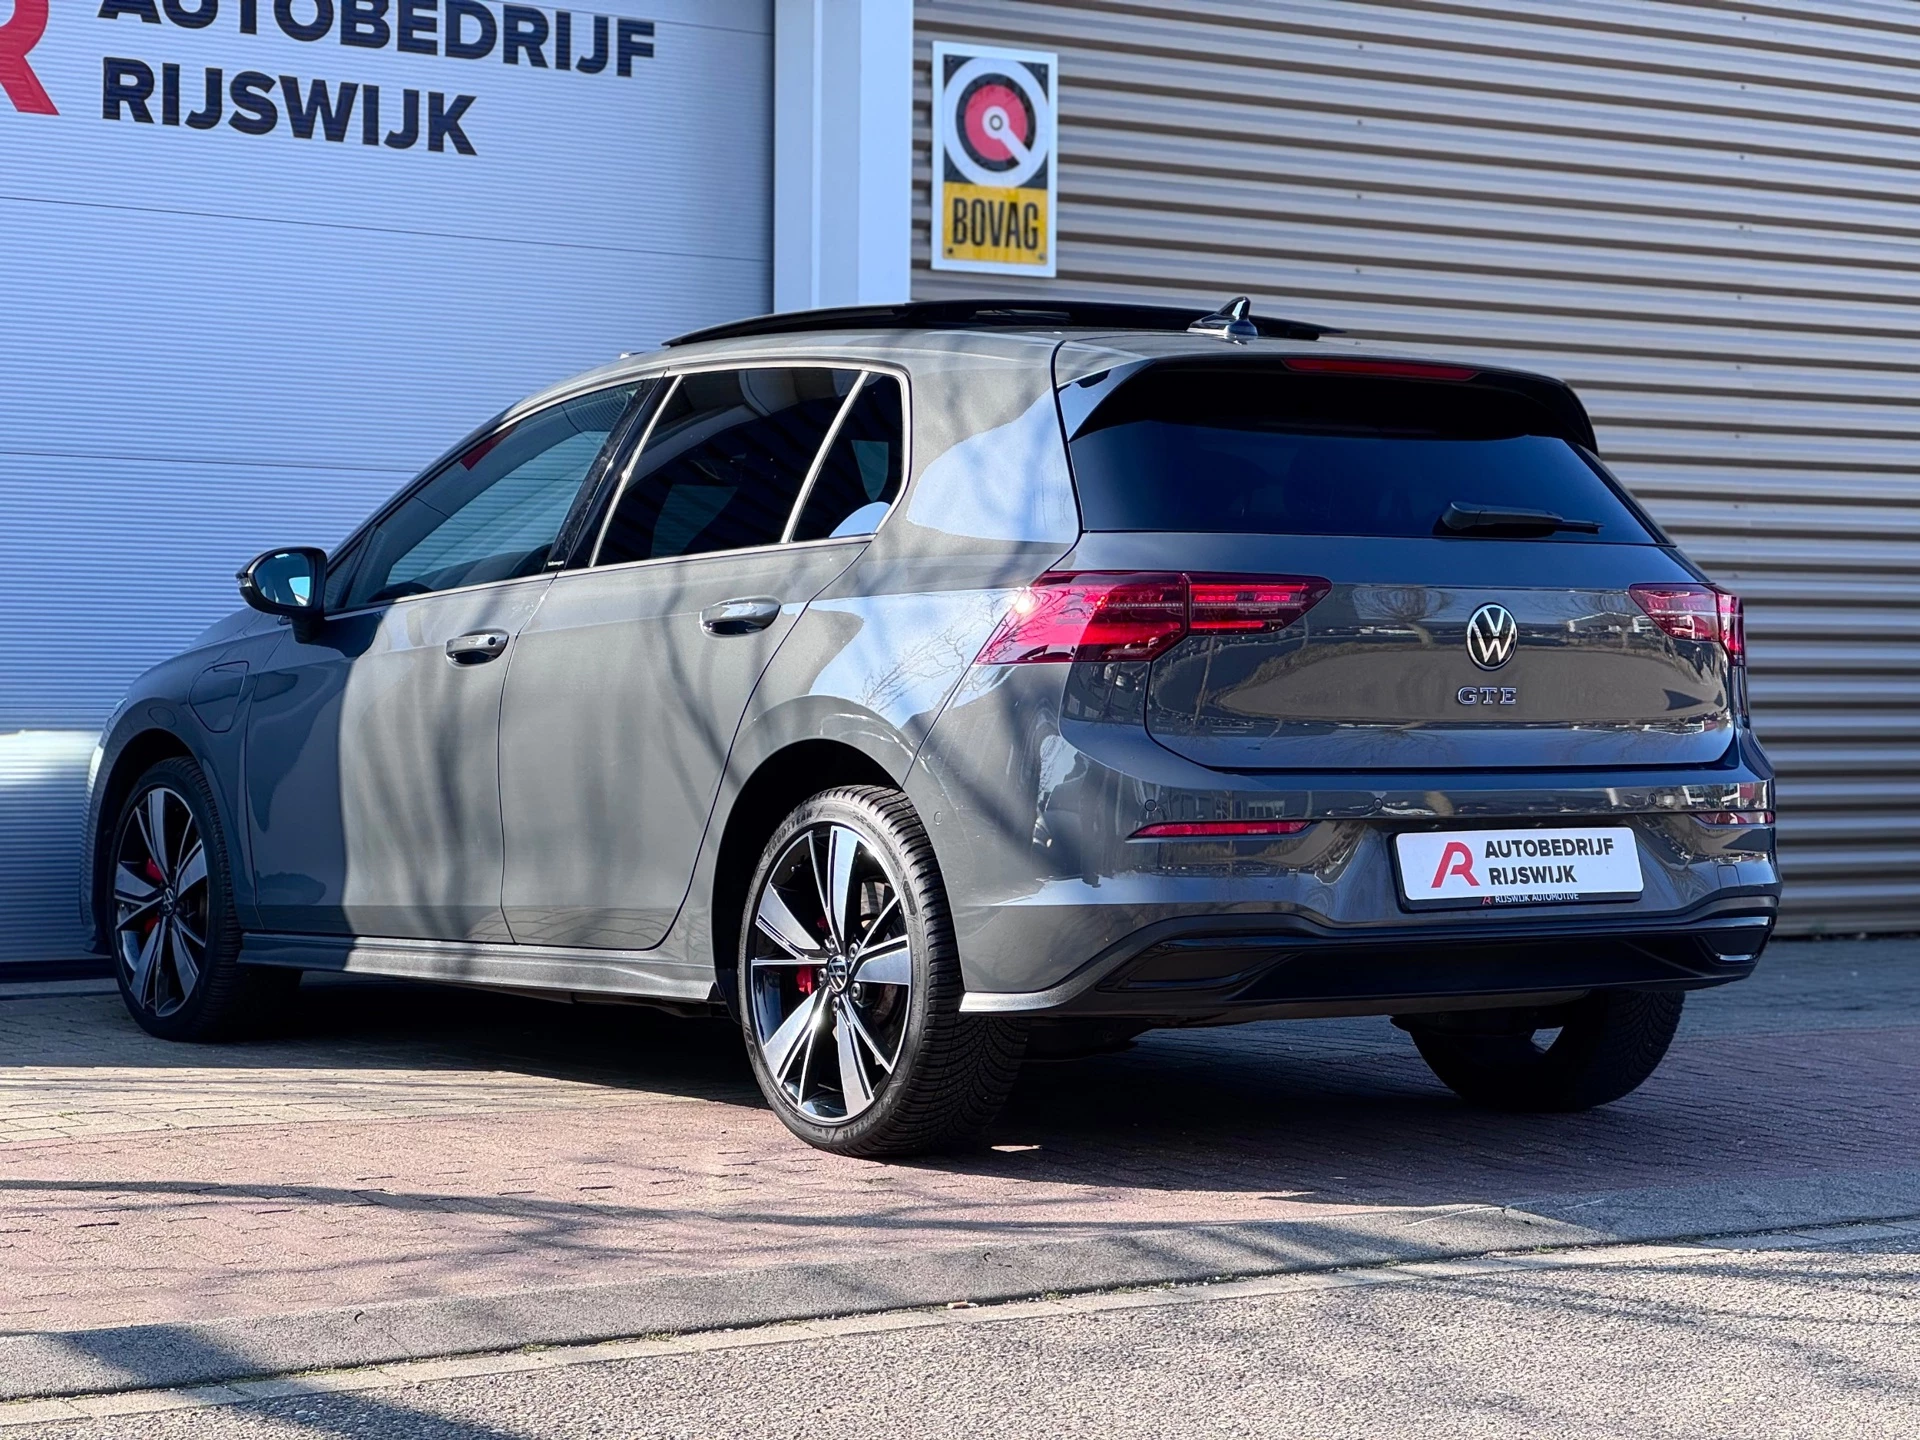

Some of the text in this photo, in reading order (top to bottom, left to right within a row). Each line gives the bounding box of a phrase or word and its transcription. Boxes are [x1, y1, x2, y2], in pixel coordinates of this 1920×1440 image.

[102, 57, 478, 156] RIJSWIJK
[952, 198, 1039, 250] BOVAG
[1457, 686, 1517, 705] GTE
[1485, 838, 1614, 859] AUTOBEDRIJF
[1488, 865, 1577, 886] RIJSWIJK
[1531, 892, 1580, 902] AUTOMOTIVE
